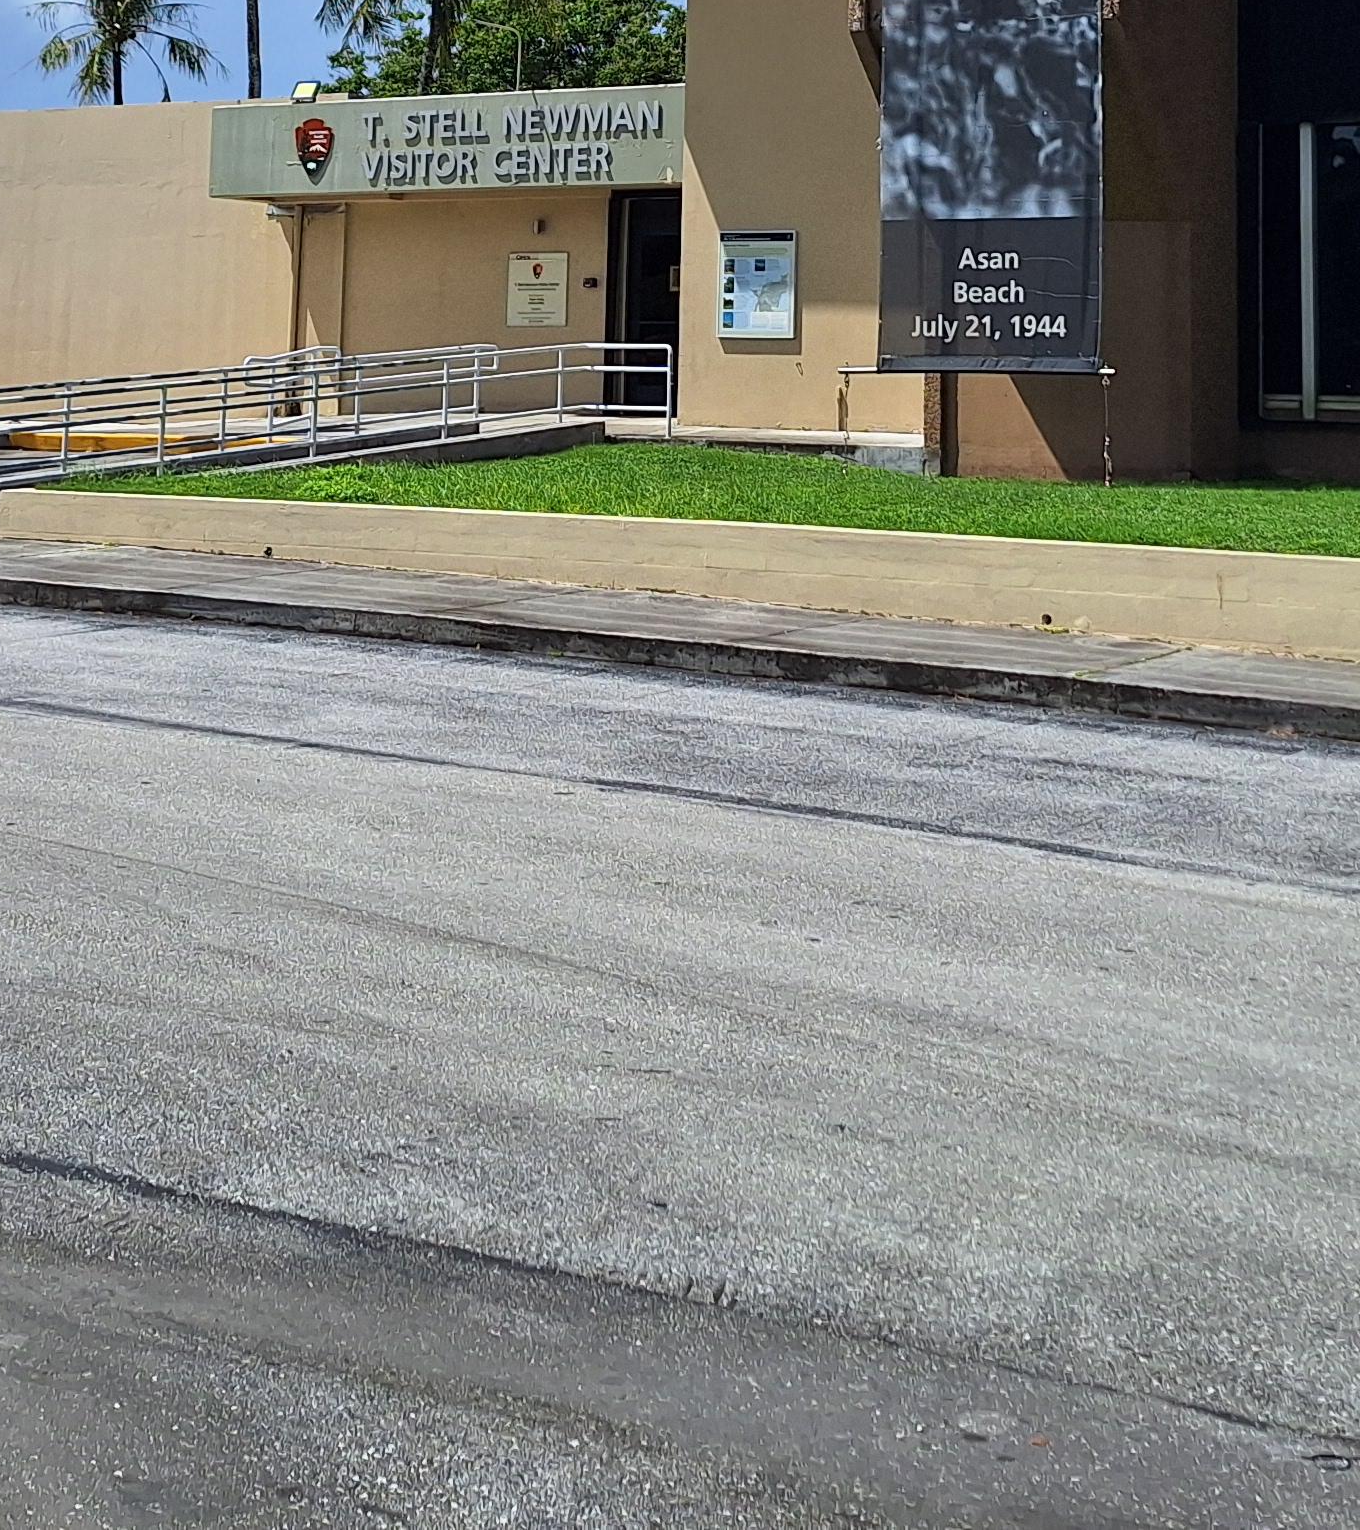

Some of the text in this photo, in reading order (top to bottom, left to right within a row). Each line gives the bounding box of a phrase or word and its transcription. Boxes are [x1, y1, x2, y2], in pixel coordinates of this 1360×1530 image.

[361, 111, 389, 142] T.
[403, 108, 488, 140] STELL
[502, 100, 661, 136] NEWMAN
[360, 142, 610, 180] VISITOR CENTER
[958, 247, 1019, 270] Asan
[953, 280, 1024, 303] Beach
[911, 313, 1067, 343] July 21, 1944
